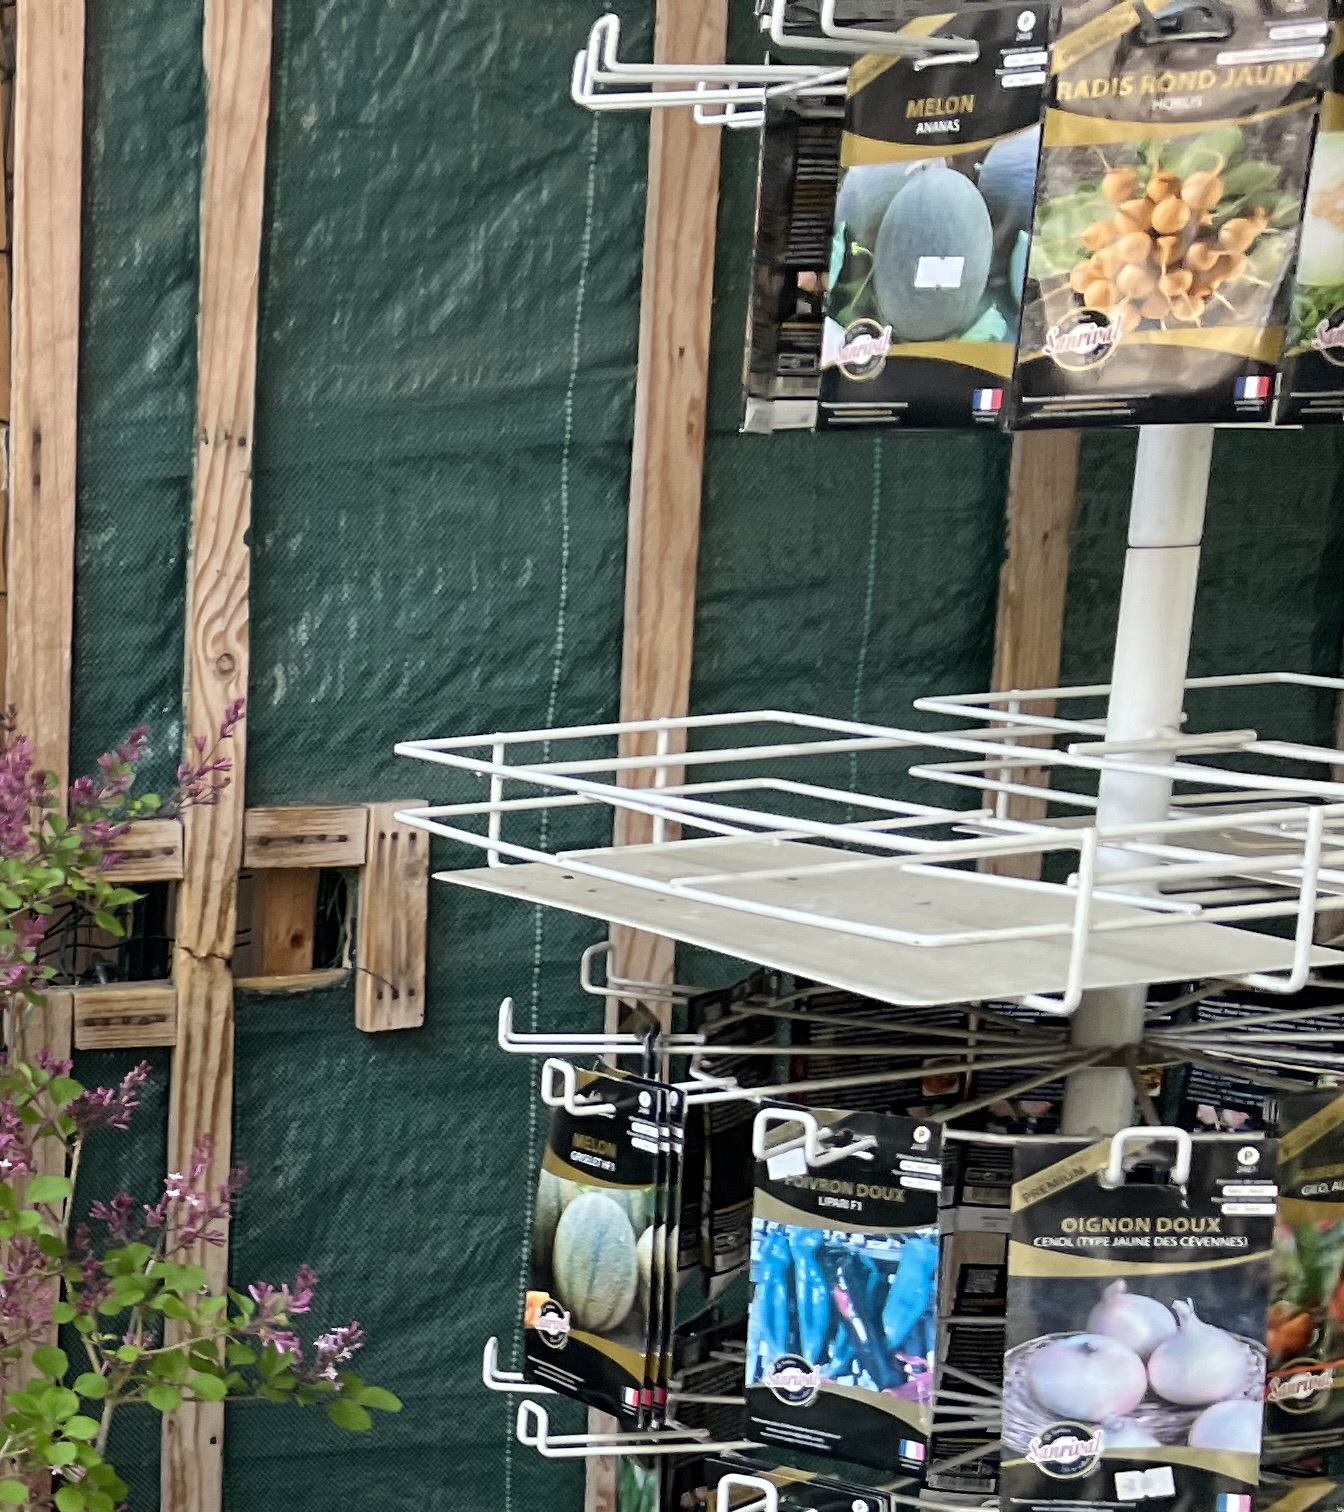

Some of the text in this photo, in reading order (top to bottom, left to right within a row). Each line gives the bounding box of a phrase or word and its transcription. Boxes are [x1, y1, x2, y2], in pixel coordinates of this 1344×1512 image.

[1056, 75, 1134, 100] RADIS
[1140, 68, 1217, 94] ROND
[905, 94, 976, 119] MELON
[915, 118, 961, 136] ANANAS
[856, 1183, 906, 1203] DOUX
[1022, 1165, 1088, 1203] PREMIUM
[1061, 1216, 1222, 1234] OIGNON DOUX
[1076, 1236, 1110, 1248] (TYPE
[1111, 1236, 1151, 1248] JAUNE
[1153, 1236, 1178, 1248] DES
[1026, 1428, 1105, 1464] Sanrival
